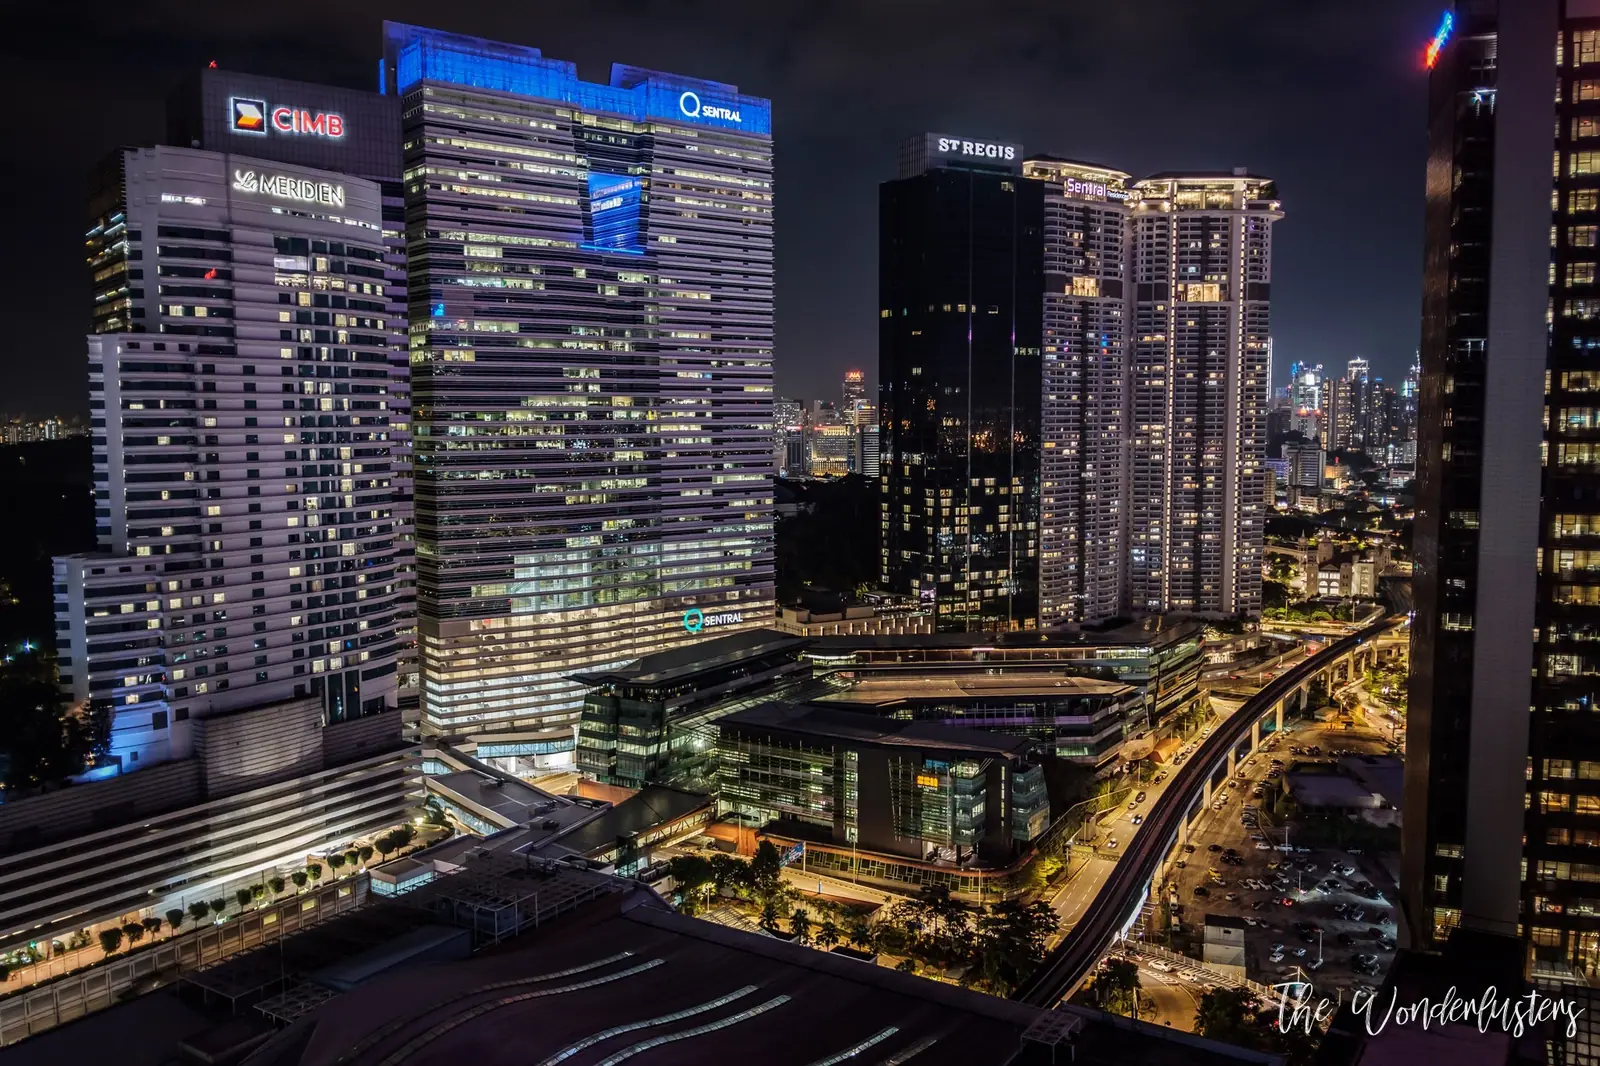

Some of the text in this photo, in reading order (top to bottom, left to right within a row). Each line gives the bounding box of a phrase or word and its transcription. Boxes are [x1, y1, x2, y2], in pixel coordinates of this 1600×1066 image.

[680, 91, 742, 123] Q SENTRAL
[272, 107, 344, 137] CIMB
[938, 137, 1015, 161] ST REGIS
[259, 173, 345, 207] MERIDIEN
[1067, 177, 1107, 197] Sentral
[683, 608, 743, 633] Q SENTRAL
